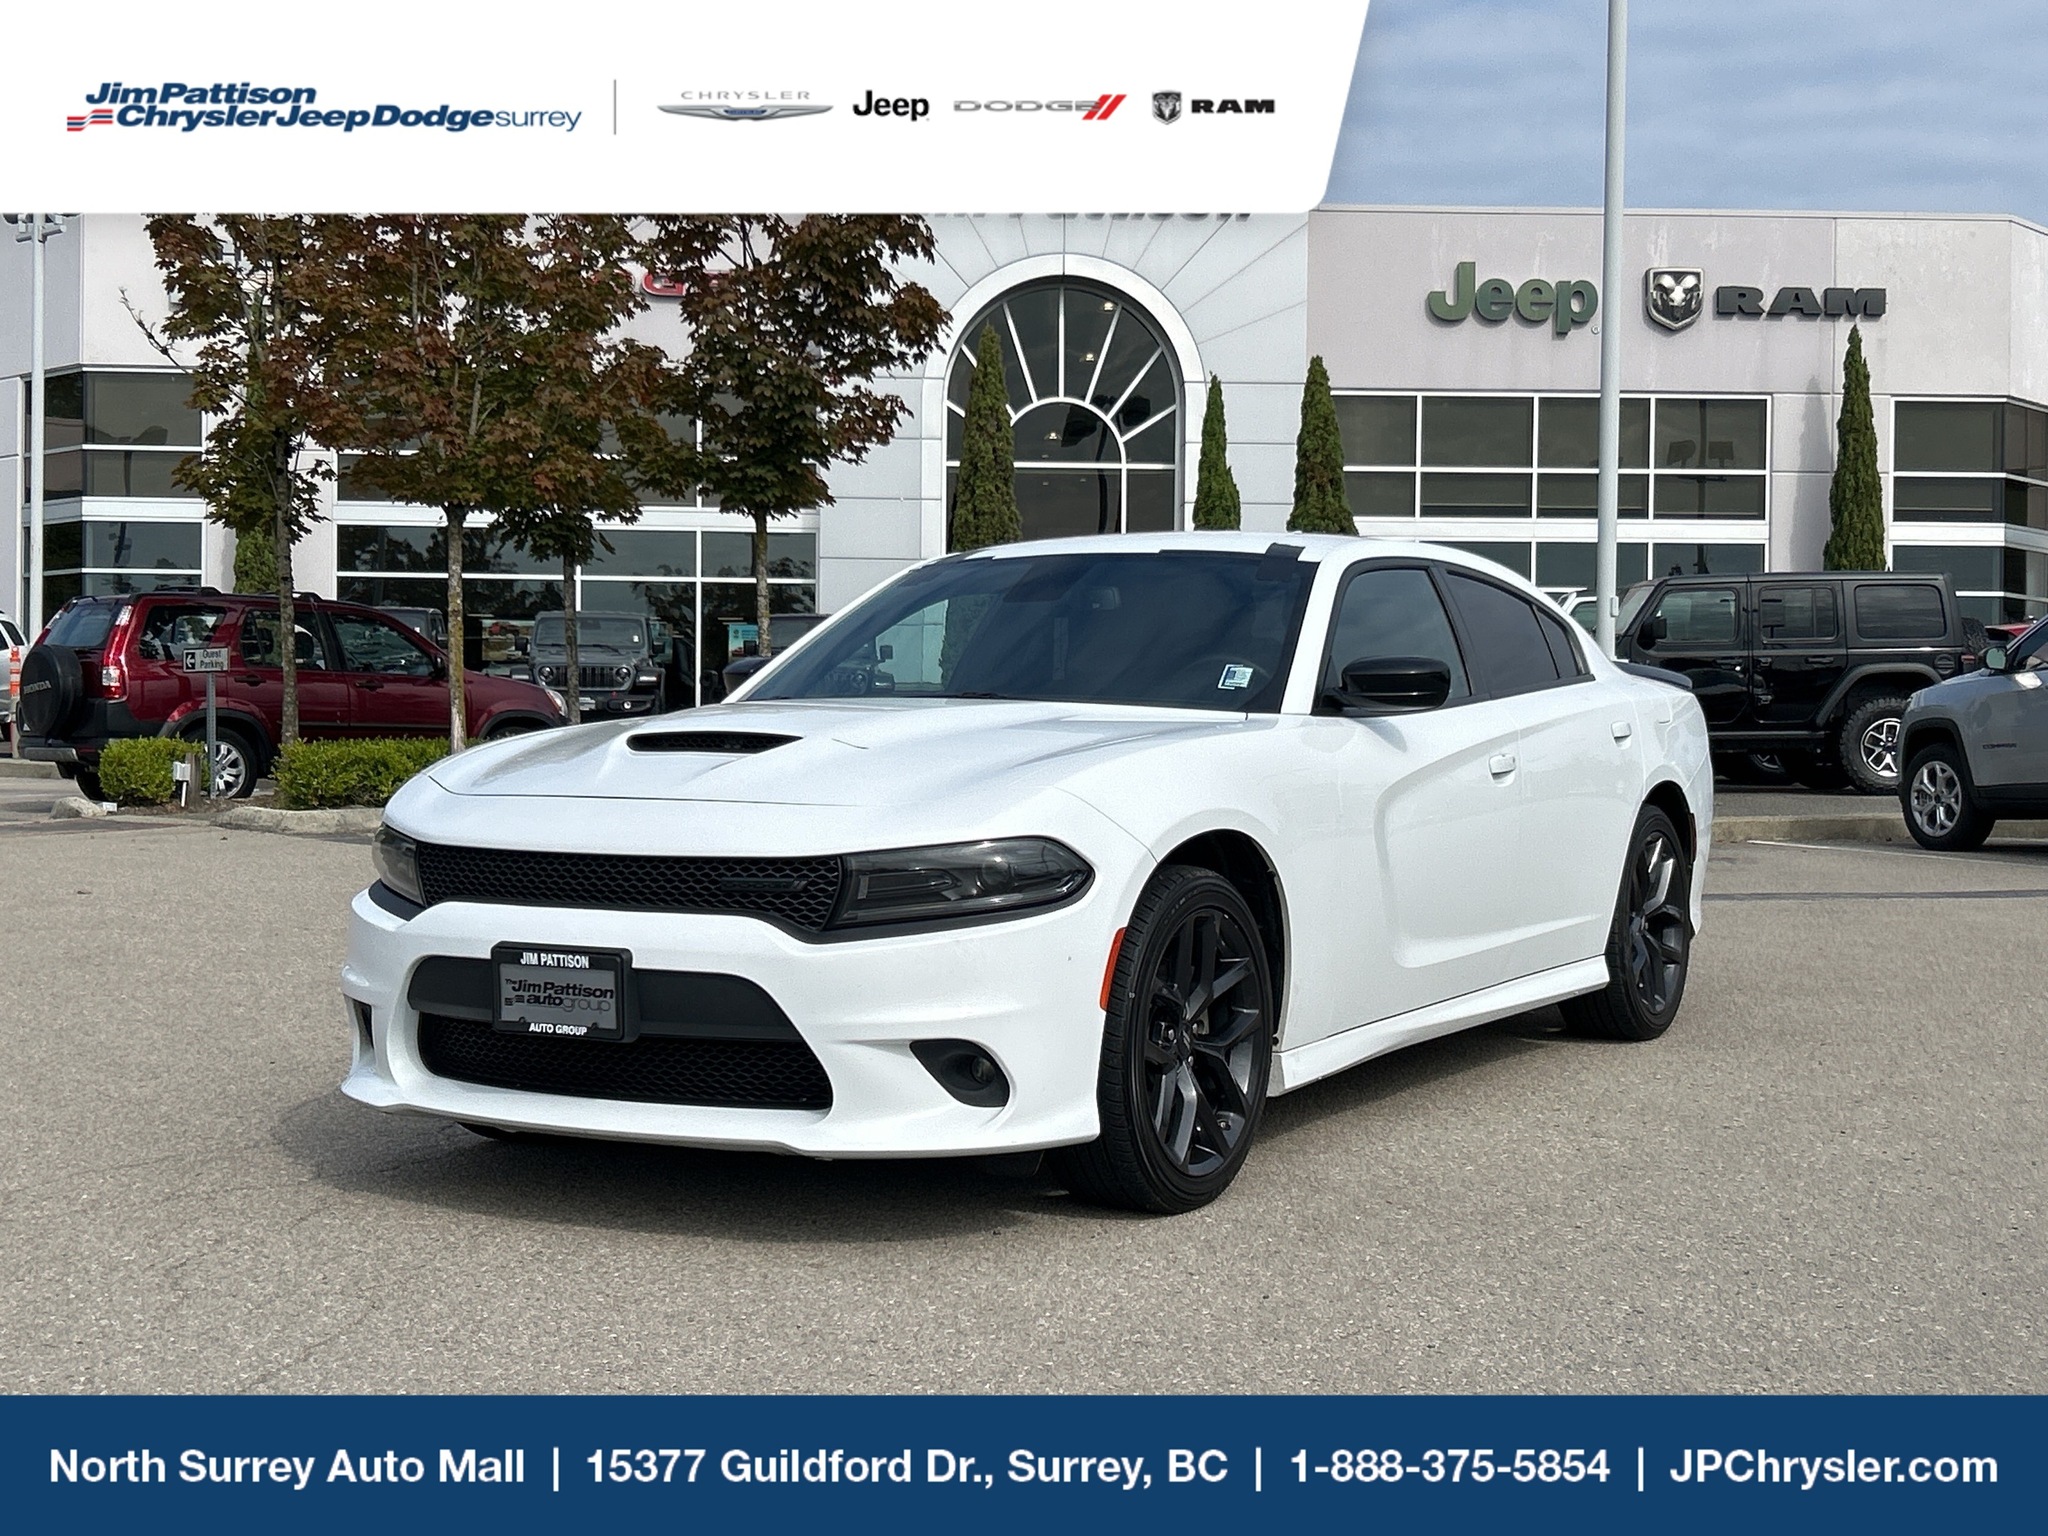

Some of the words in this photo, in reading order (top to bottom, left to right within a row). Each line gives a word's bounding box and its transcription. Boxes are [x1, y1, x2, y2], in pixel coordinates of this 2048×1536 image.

[1427, 261, 1599, 335] Jeep
[1715, 286, 1887, 316] RAM
[23, 680, 52, 694] HONDA
[520, 952, 538, 965] JIM
[540, 953, 590, 968] PATTISON
[529, 1022, 553, 1033] AUTO
[556, 1025, 587, 1036] GROUP
